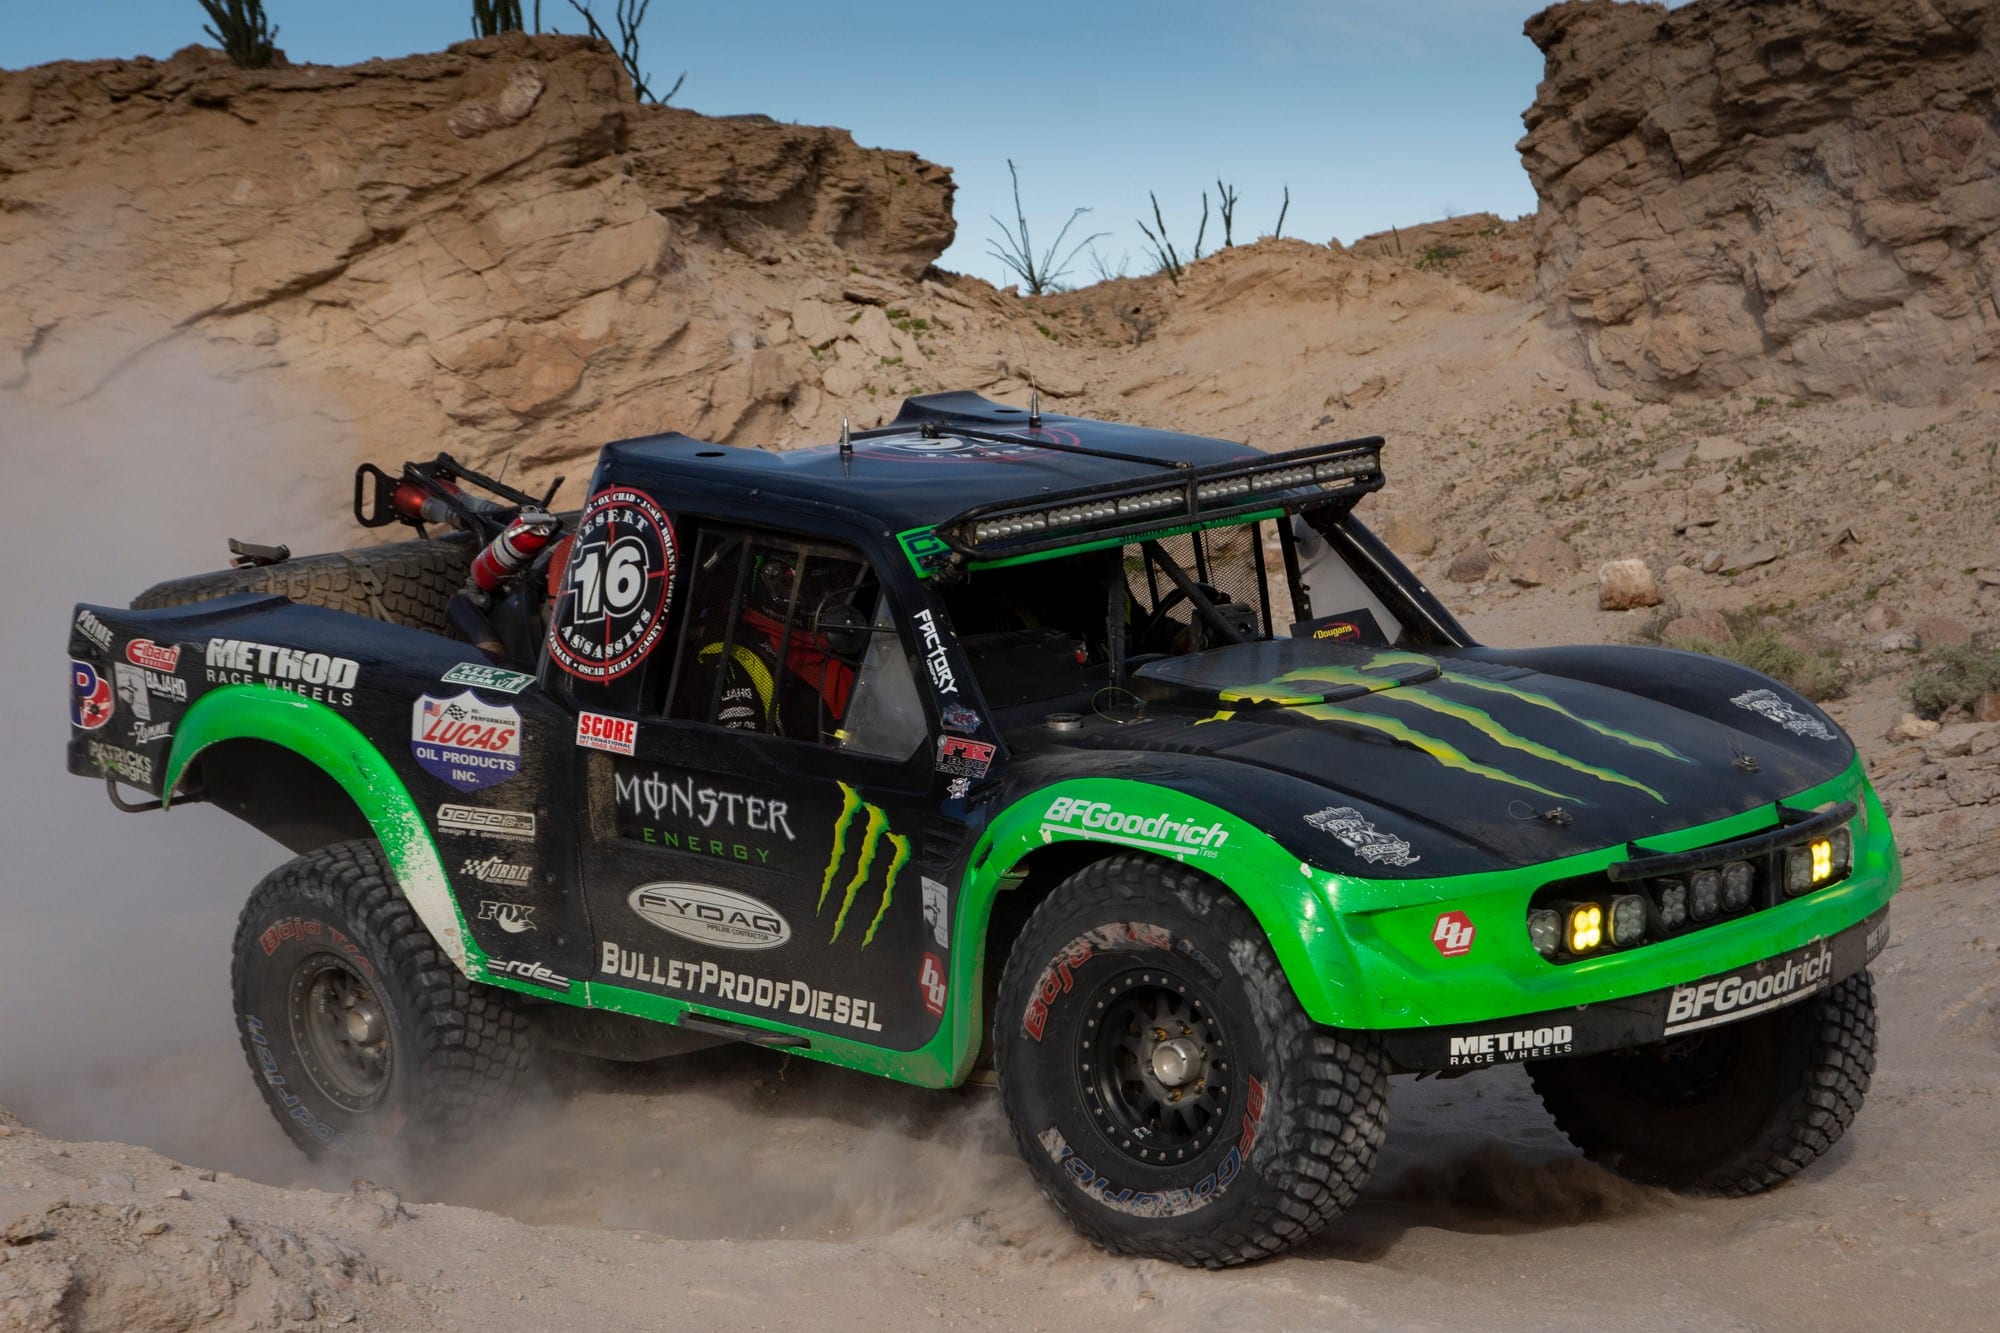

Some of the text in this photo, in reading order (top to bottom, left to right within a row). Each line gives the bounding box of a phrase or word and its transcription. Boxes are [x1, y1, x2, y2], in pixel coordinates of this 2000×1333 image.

[570, 539, 648, 622] 16
[560, 606, 652, 659] ASSASSINS
[638, 621, 662, 654] CASEY
[127, 638, 180, 663] Eibach
[205, 638, 360, 689] METHOD
[577, 655, 633, 676] OSCAR KURT
[912, 608, 959, 695] FACTORY
[206, 668, 354, 707] RACE WHEELS
[422, 719, 516, 752] LUCAS
[470, 715, 516, 727] PERFORMANCE
[580, 714, 635, 744] SCORE
[87, 740, 153, 774] PATRICKS
[579, 734, 632, 749] INTERNATIONAL
[416, 747, 516, 772] OIL PRODUCTS
[452, 768, 480, 784] INC.
[614, 771, 796, 843] MONSTER
[1044, 797, 1230, 848] BFGoodrich
[643, 827, 769, 864] ENERGY
[1198, 846, 1218, 859] Tires
[477, 900, 536, 926] FOX
[638, 894, 781, 935] FYDAQ
[260, 916, 322, 956] Baja
[706, 923, 769, 942] PIPELINE CONTRACTOR
[1022, 938, 1093, 1042] Baja
[1667, 945, 1833, 1024] BFGoodrich
[1450, 1025, 1573, 1056] METHOD
[1450, 1043, 1573, 1066] RACE WHEELS
